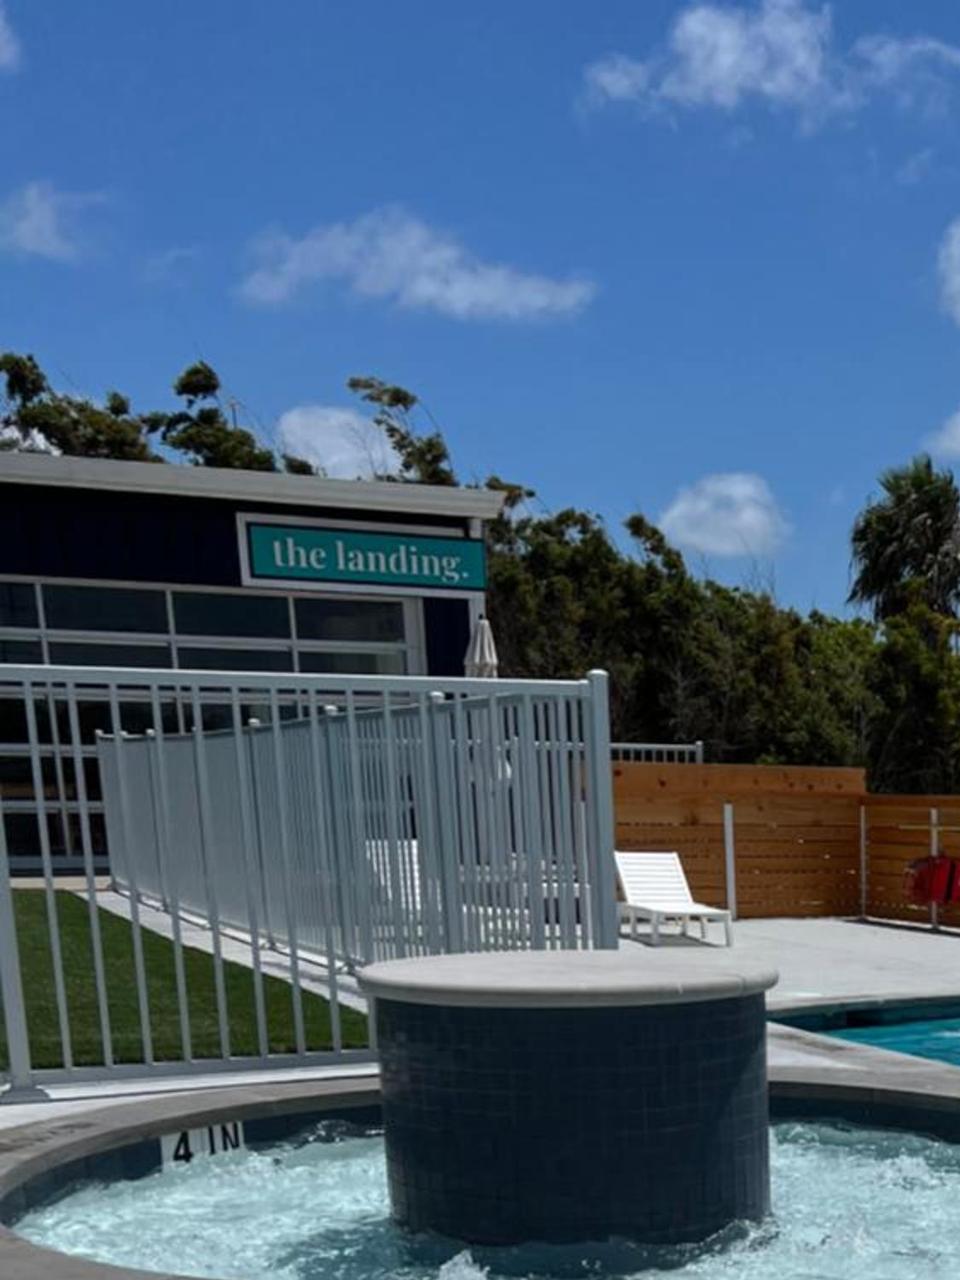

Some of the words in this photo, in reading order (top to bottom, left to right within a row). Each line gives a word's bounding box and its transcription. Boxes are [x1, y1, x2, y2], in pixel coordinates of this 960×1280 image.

[273, 537, 327, 569] the
[335, 540, 470, 583] landing.
[173, 1131, 193, 1163] 4
[208, 1122, 240, 1155] IN
